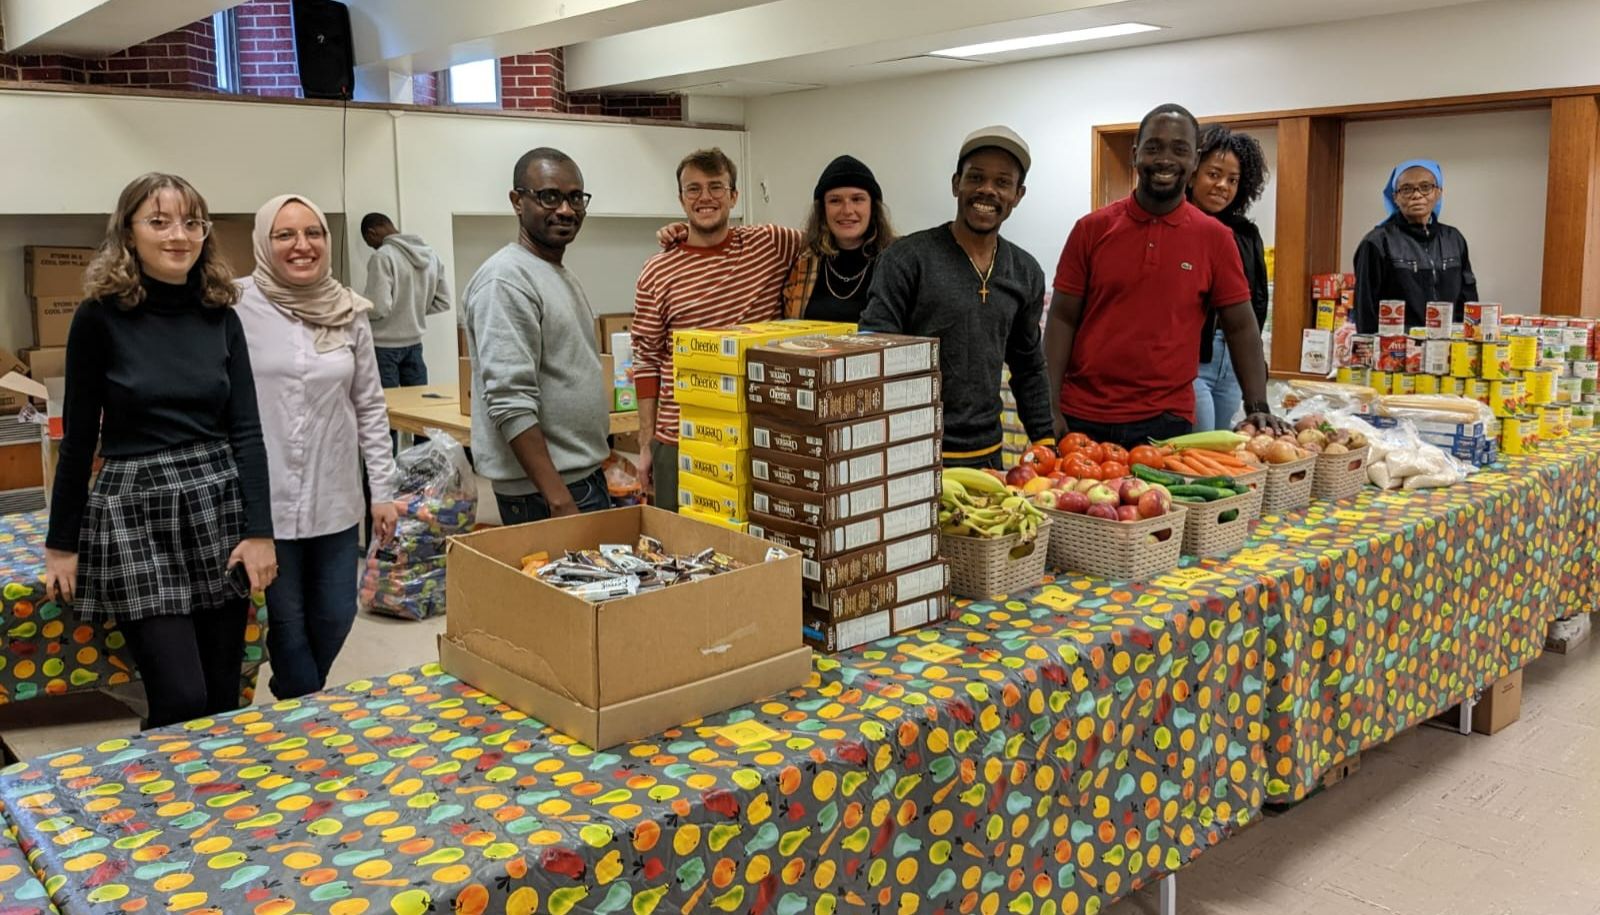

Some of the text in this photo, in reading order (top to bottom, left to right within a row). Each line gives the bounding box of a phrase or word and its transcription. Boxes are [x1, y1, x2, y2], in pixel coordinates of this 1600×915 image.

[690, 336, 719, 354] Cheerios
[690, 372, 719, 390] Cheerios
[695, 424, 723, 442] Cheerios
[694, 460, 719, 478] Cheerios
[694, 494, 721, 513] Cheerios
